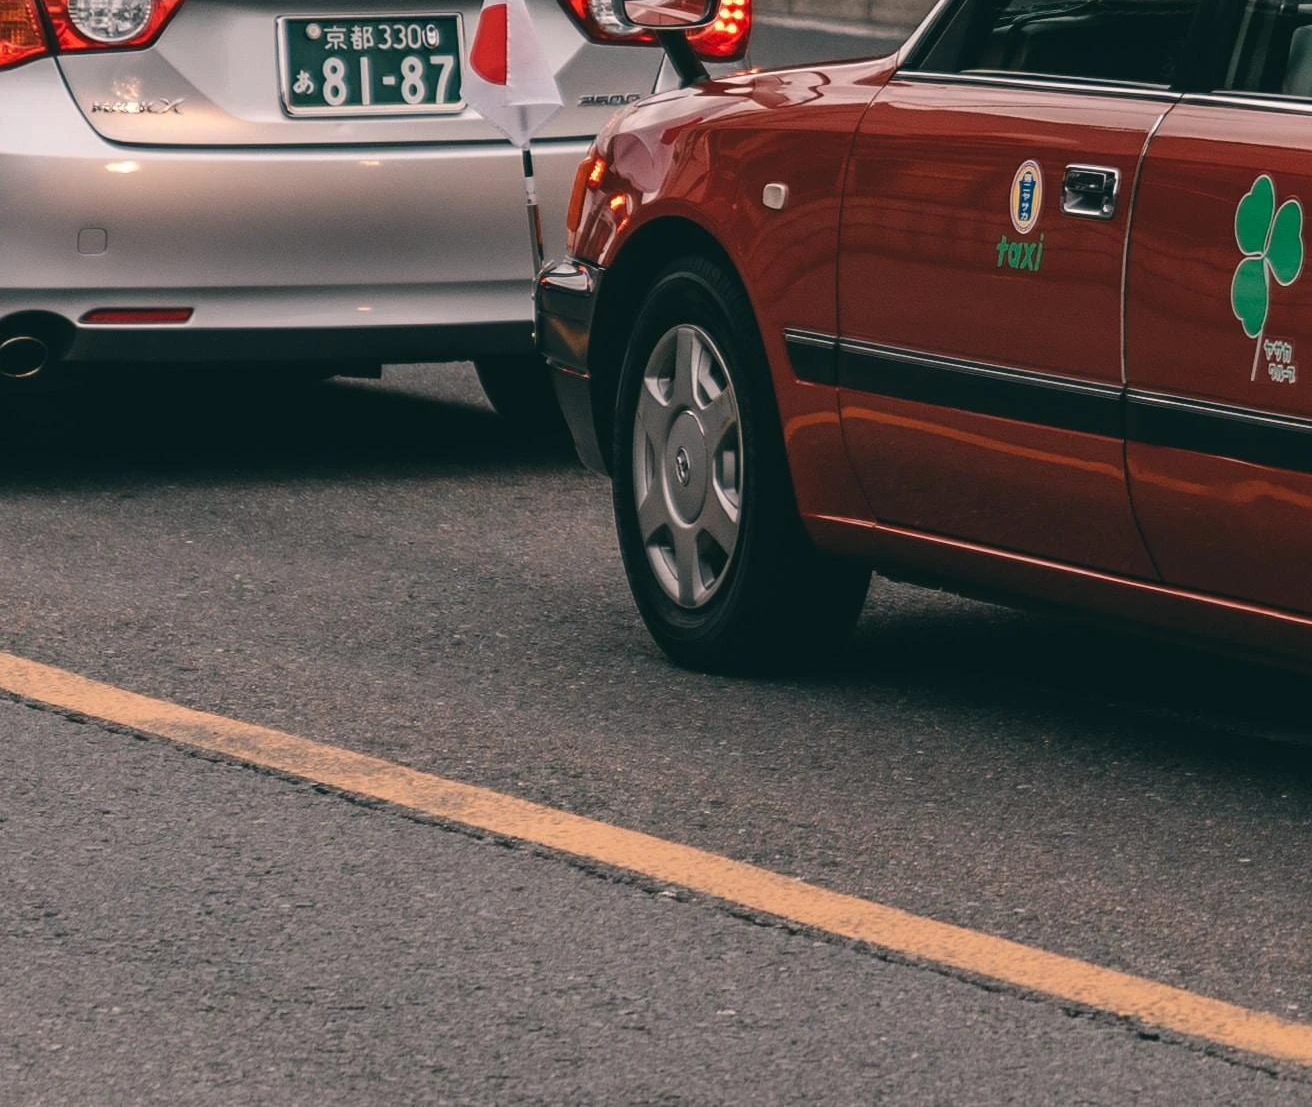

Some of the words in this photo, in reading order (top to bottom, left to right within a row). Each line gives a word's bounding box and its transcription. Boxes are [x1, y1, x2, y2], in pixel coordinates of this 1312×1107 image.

[293, 70, 314, 94] あ
[322, 55, 453, 106] 81-87
[996, 233, 1044, 271] taxi
[1264, 339, 1292, 364] ヤサカ
